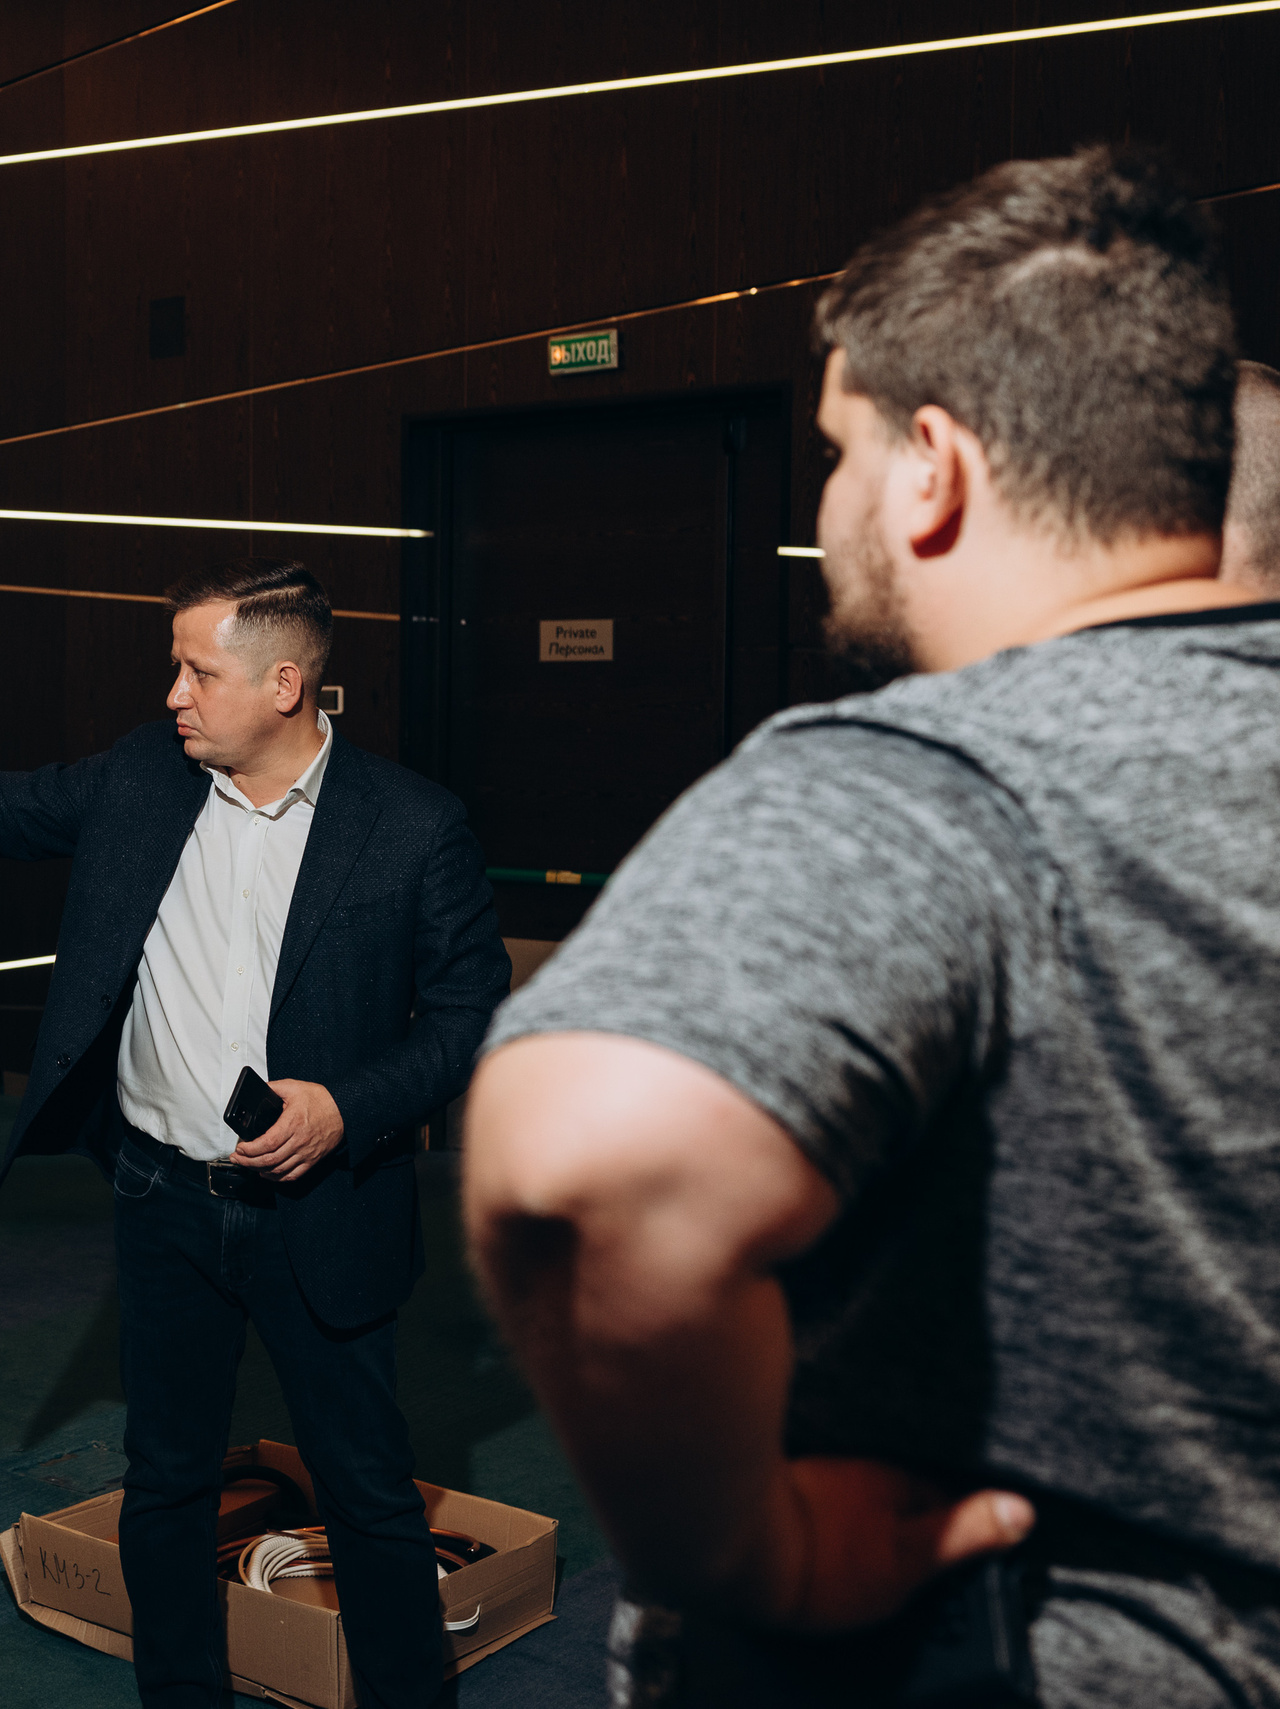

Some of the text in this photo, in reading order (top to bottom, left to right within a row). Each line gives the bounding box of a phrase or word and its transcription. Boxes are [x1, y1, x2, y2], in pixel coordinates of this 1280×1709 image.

[550, 339, 610, 365] ВЫХОД
[556, 626, 597, 639] Private
[549, 642, 605, 657] Персонал
